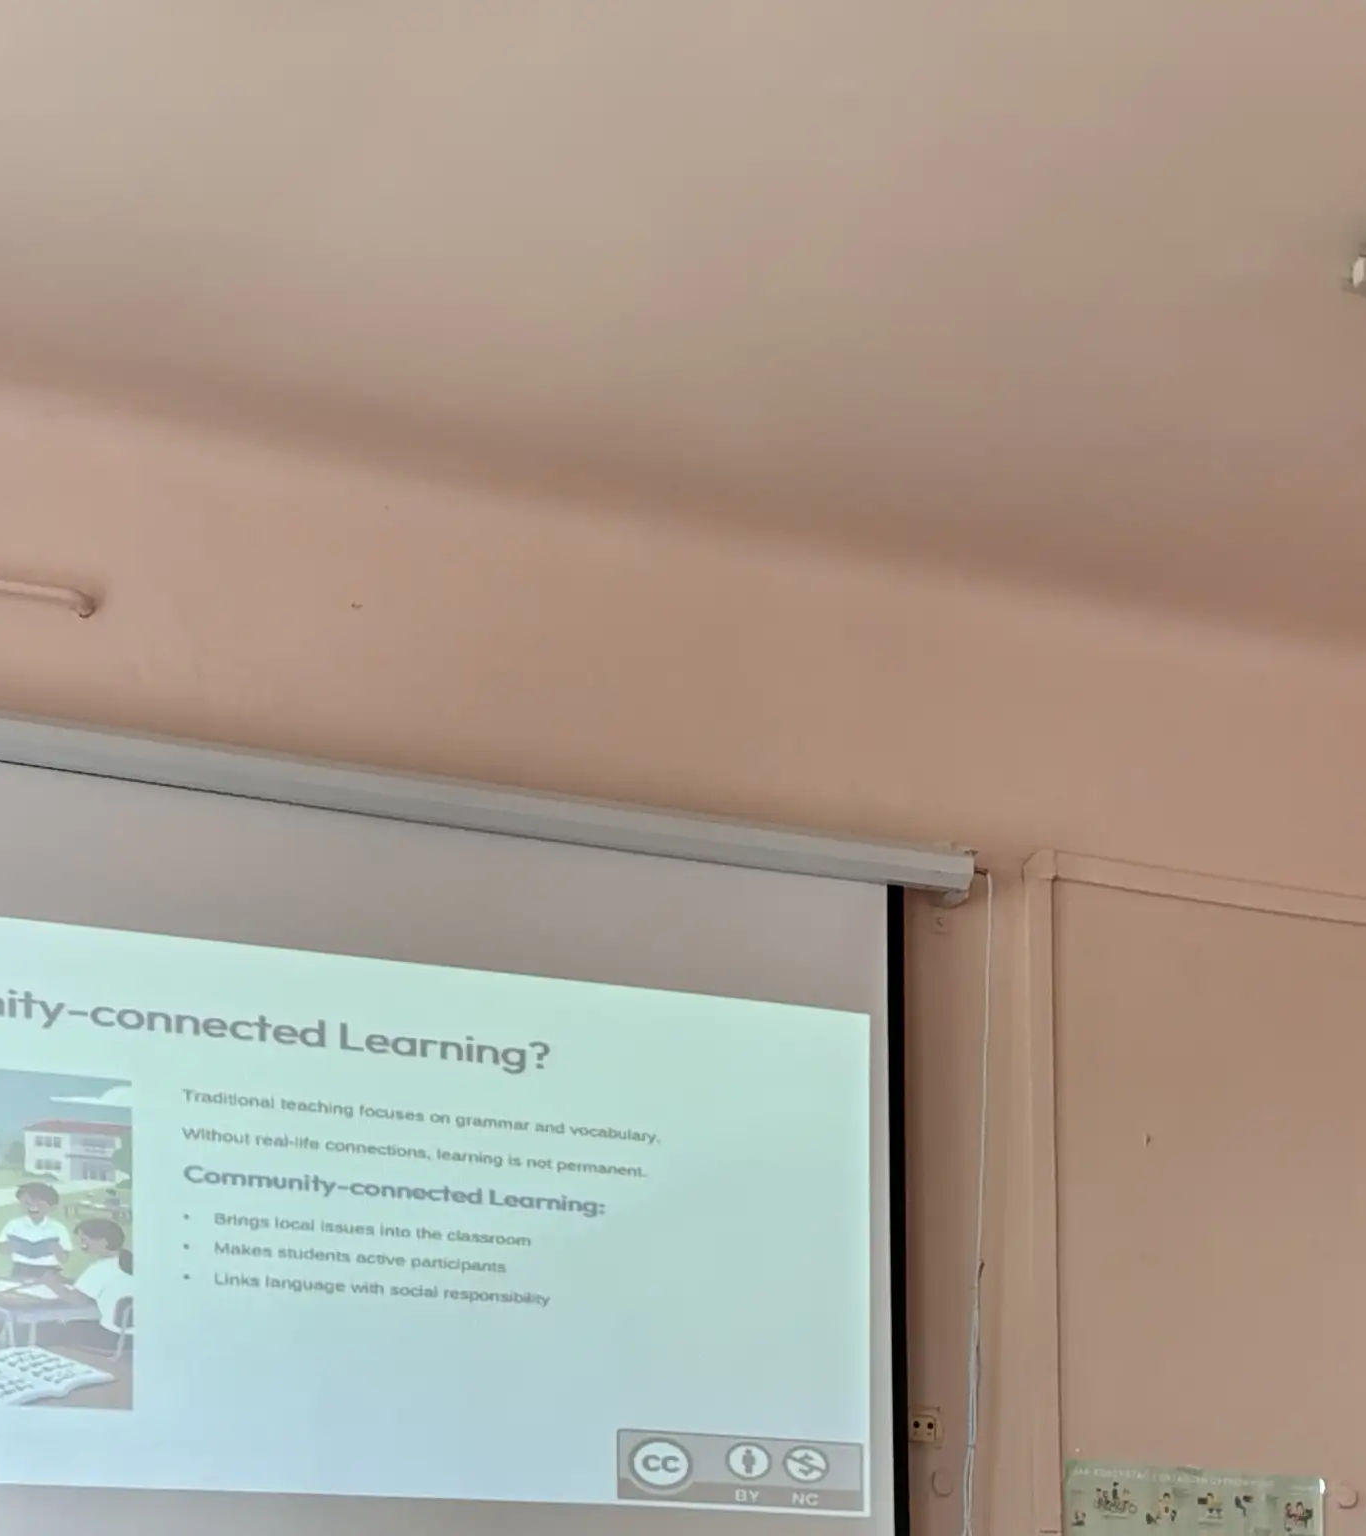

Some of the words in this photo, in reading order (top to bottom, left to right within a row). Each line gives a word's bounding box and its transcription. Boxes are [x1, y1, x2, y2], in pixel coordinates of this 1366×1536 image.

[339, 1021, 551, 1075] Learning?
[183, 1088, 275, 1109] Traditional
[281, 1096, 354, 1118] teaching
[359, 1103, 425, 1122] focuses
[429, 1111, 451, 1125] on
[455, 1114, 530, 1131] grammar
[534, 1121, 566, 1135] and
[569, 1125, 662, 1145] vocabulary.
[182, 1126, 250, 1146] Without
[255, 1132, 320, 1150] real-life
[325, 1138, 431, 1161] connections,
[437, 1148, 503, 1168] learning
[508, 1153, 522, 1167] is
[526, 1156, 554, 1171] not
[556, 1158, 648, 1179] permanent.
[183, 1164, 483, 1206] Community-connected
[489, 1188, 606, 1219] Learning:
[214, 1212, 270, 1231] Brings
[275, 1215, 315, 1232] local
[321, 1220, 375, 1236] issues
[380, 1223, 411, 1239] into
[416, 1226, 442, 1241] the
[446, 1229, 532, 1248] classroom
[214, 1241, 273, 1258] Makes
[278, 1246, 351, 1264] students
[356, 1251, 406, 1267] active
[410, 1255, 507, 1275] participants
[214, 1271, 260, 1288] Links
[265, 1275, 346, 1294] language
[351, 1280, 385, 1296] with
[389, 1284, 437, 1299] social
[443, 1287, 551, 1308] responsibility
[734, 1489, 761, 1504] BY
[792, 1492, 820, 1506] NC
